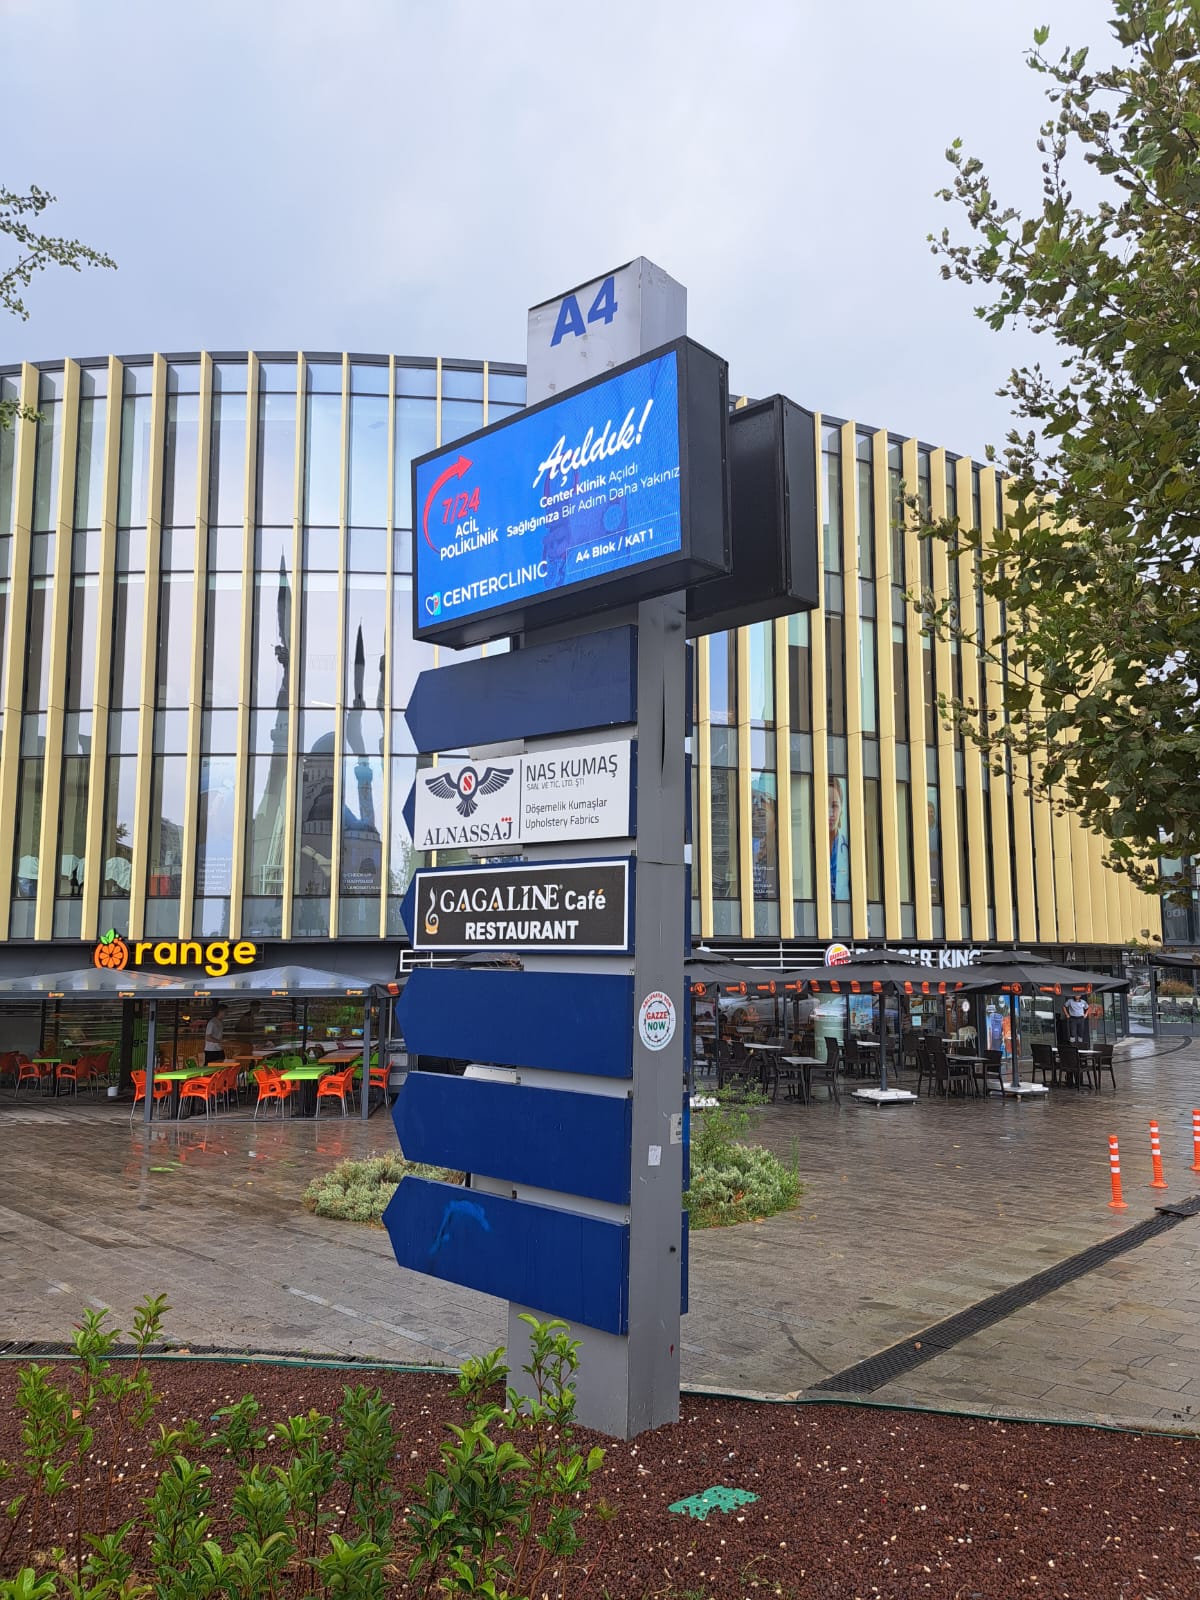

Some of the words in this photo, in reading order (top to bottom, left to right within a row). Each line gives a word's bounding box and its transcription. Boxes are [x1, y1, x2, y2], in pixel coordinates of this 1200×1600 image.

[550, 276, 618, 347] A4
[532, 399, 654, 487] Açıldık!
[539, 489, 575, 508] Center
[576, 475, 607, 495] Klinik
[608, 464, 639, 485] Açıldı
[441, 487, 481, 525] 7/24
[506, 511, 560, 539] Sağlığınıza
[561, 500, 576, 518] Bir
[577, 491, 607, 514] Adım
[609, 483, 638, 501] Daha
[455, 514, 480, 539] ACİL
[440, 526, 499, 560] POLİKLİNİK
[575, 549, 590, 564] A4
[592, 540, 615, 559] Blok
[617, 538, 623, 553] /
[625, 532, 647, 548] KAT
[648, 528, 654, 541] 1
[443, 560, 548, 608] CENTERCLINIC
[526, 762, 556, 782] NAS
[560, 754, 618, 778] KUMAŞ
[525, 801, 567, 815] Döşemelik
[568, 797, 608, 811] Kumaşlar
[525, 817, 568, 830] Upholstery
[570, 814, 600, 825] Fabrics
[564, 888, 607, 911] Café
[465, 920, 579, 940] RESTAURANT
[1066, 951, 1076, 961] A4
[646, 1011, 668, 1020] GAZZE
[647, 1021, 666, 1031] NOW
